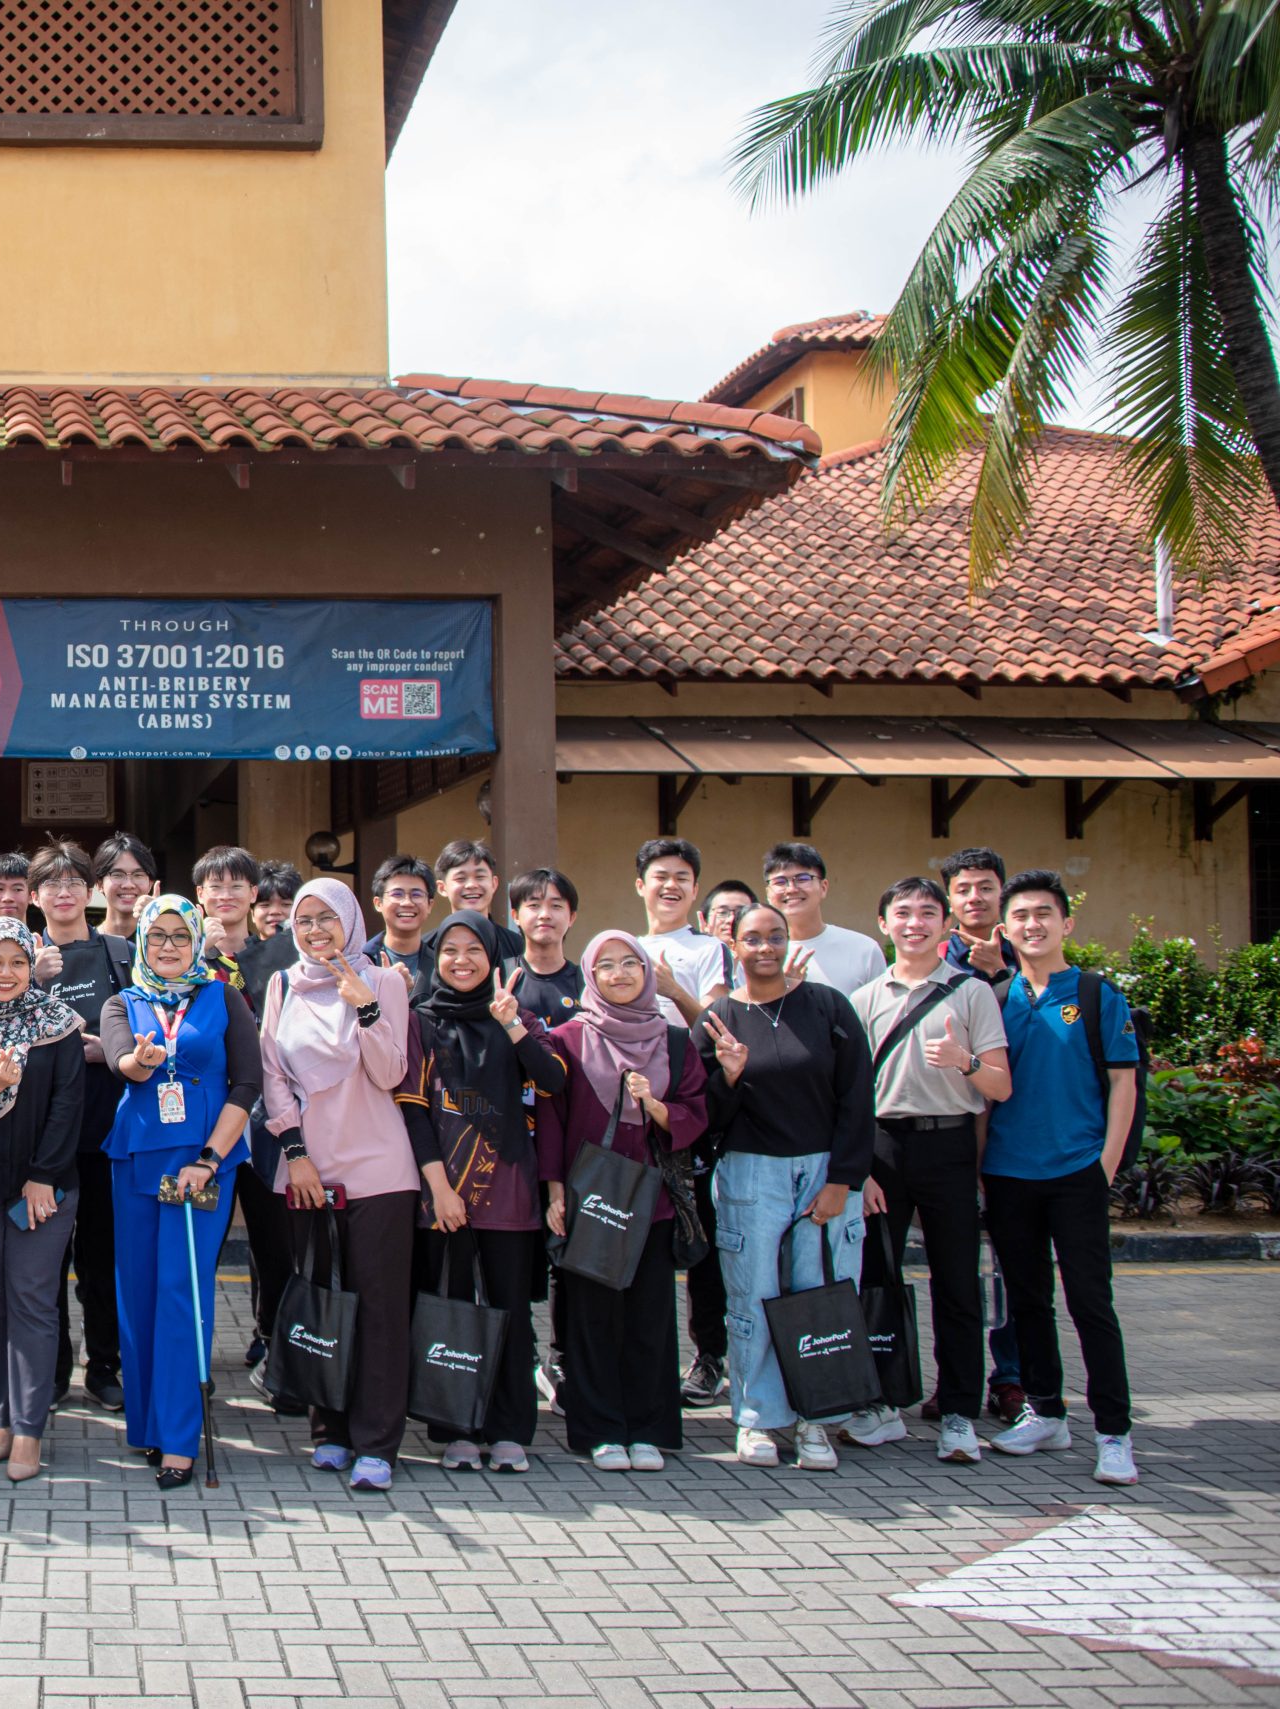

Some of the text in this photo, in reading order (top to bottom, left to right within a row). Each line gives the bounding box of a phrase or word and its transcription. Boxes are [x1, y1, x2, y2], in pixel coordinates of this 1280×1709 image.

[120, 620, 229, 632] THROUGH
[66, 643, 285, 669] ISO 37001:2016
[331, 648, 465, 660] Scan the QR Code to report
[346, 661, 453, 673] any improper conduct
[98, 676, 251, 692] ANTI-BRIBERY
[363, 684, 398, 695] SCAN
[50, 693, 291, 709] MANAGEMENT SYSTEM
[363, 697, 398, 714] ME
[138, 713, 213, 729] (ABMS)
[91, 749, 212, 759] www.johorport.com.my
[355, 747, 460, 758] Johor Port Malaysia
[61, 981, 94, 993] JohorPort
[597, 1202, 630, 1220] JohorPort
[302, 1331, 334, 1348] JohorPort
[812, 1332, 849, 1346] JohorPort
[442, 1349, 479, 1363] JohorPort
